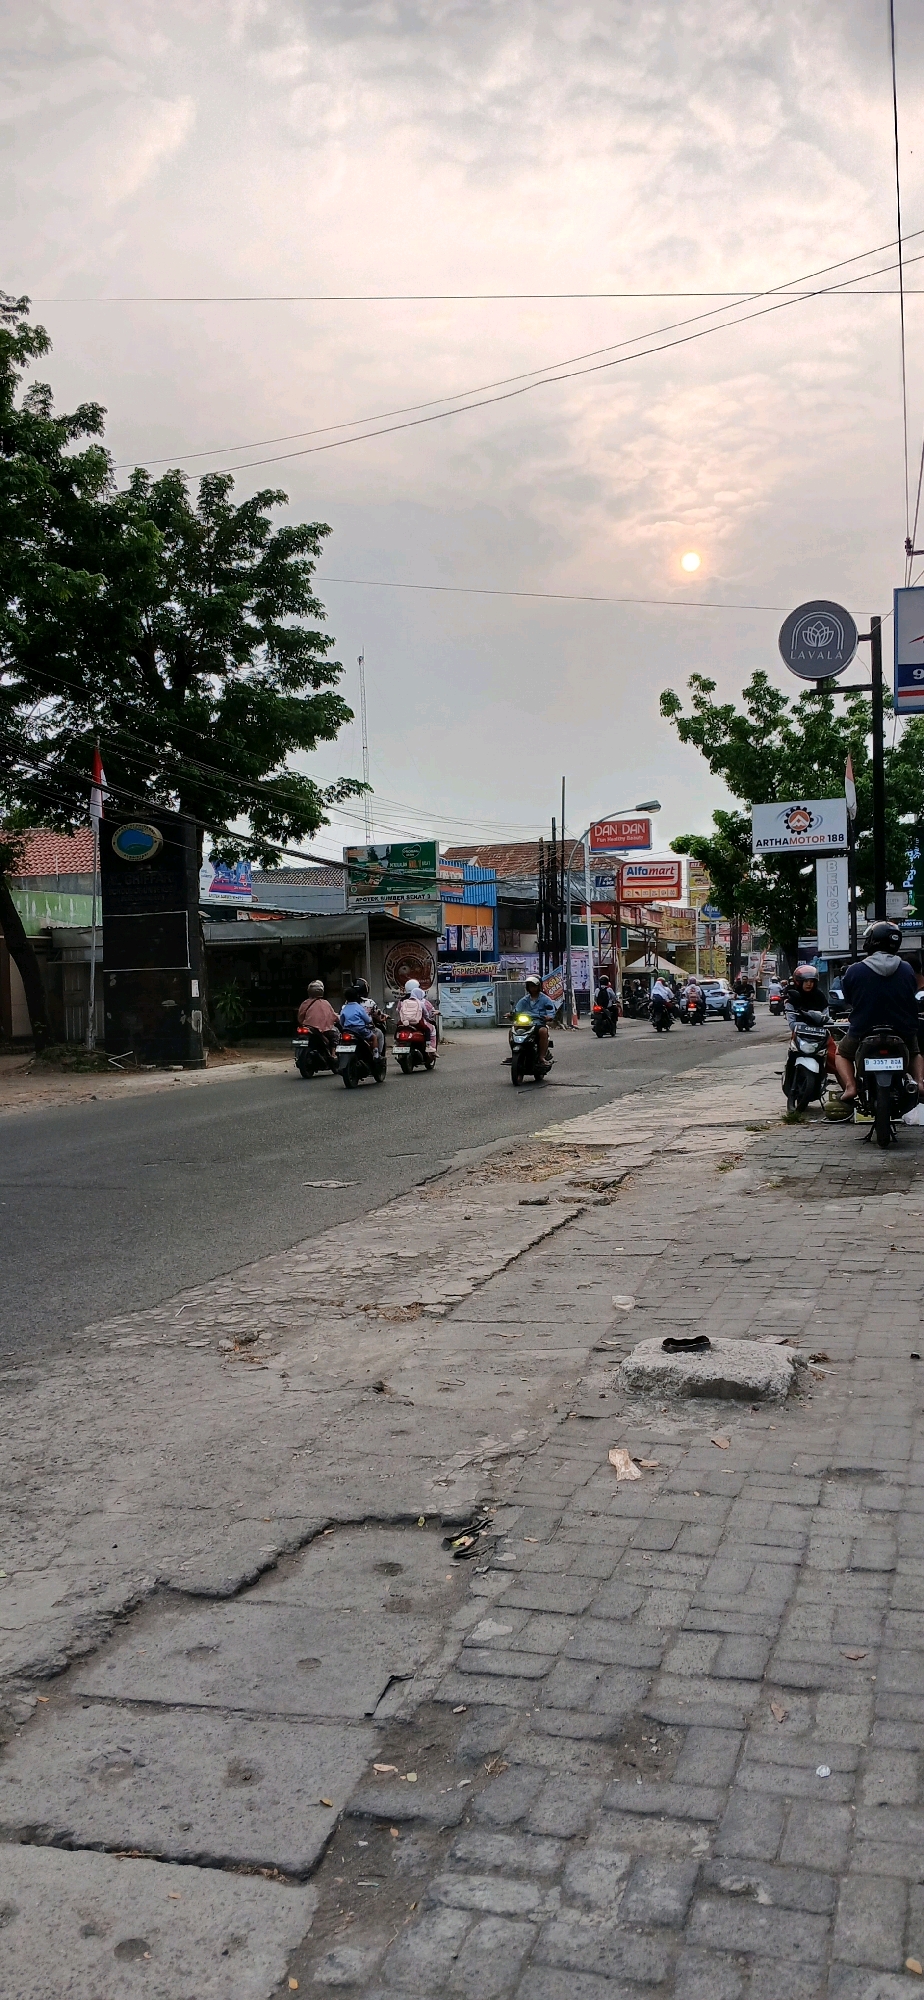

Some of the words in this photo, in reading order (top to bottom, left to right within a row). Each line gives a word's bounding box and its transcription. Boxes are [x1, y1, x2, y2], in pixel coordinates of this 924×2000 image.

[790, 650, 843, 660] LAVALA
[594, 824, 618, 837] DAN
[622, 822, 646, 835] DAN
[755, 835, 825, 848] ARTHAMOTOR
[827, 833, 845, 843] 188
[626, 866, 675, 876] Alfamart
[825, 860, 840, 950] BENGKEL
